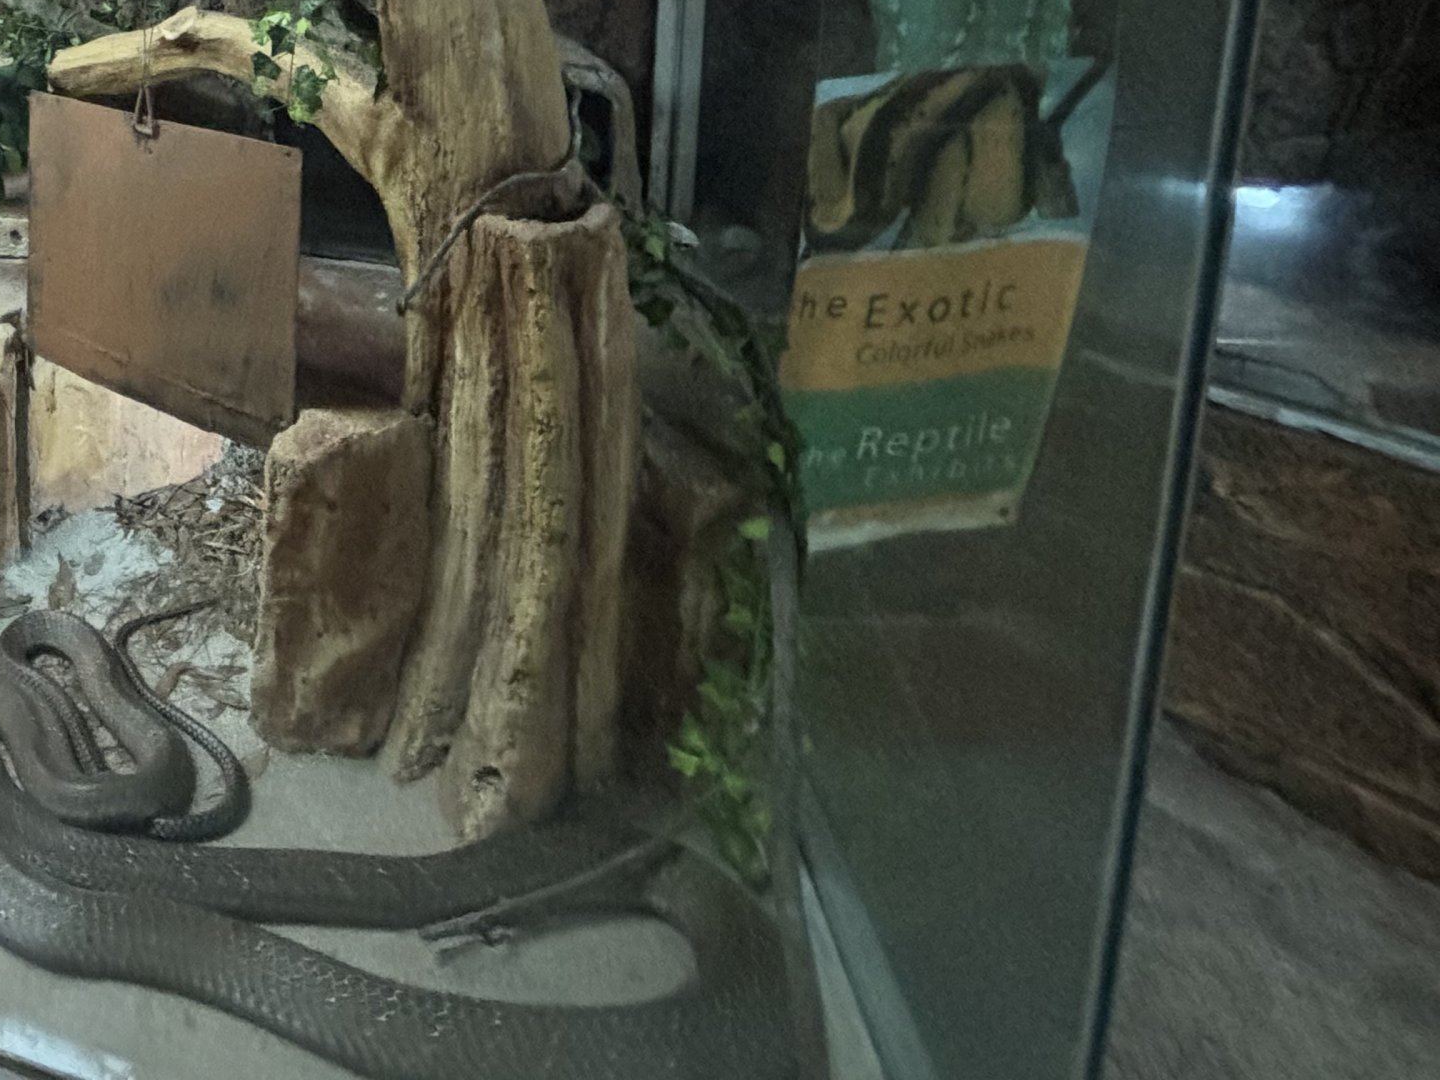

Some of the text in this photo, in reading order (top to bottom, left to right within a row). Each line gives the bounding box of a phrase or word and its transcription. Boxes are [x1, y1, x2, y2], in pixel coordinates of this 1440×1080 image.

[798, 281, 1016, 330] he Exotic
[856, 411, 1012, 464] Reptile
